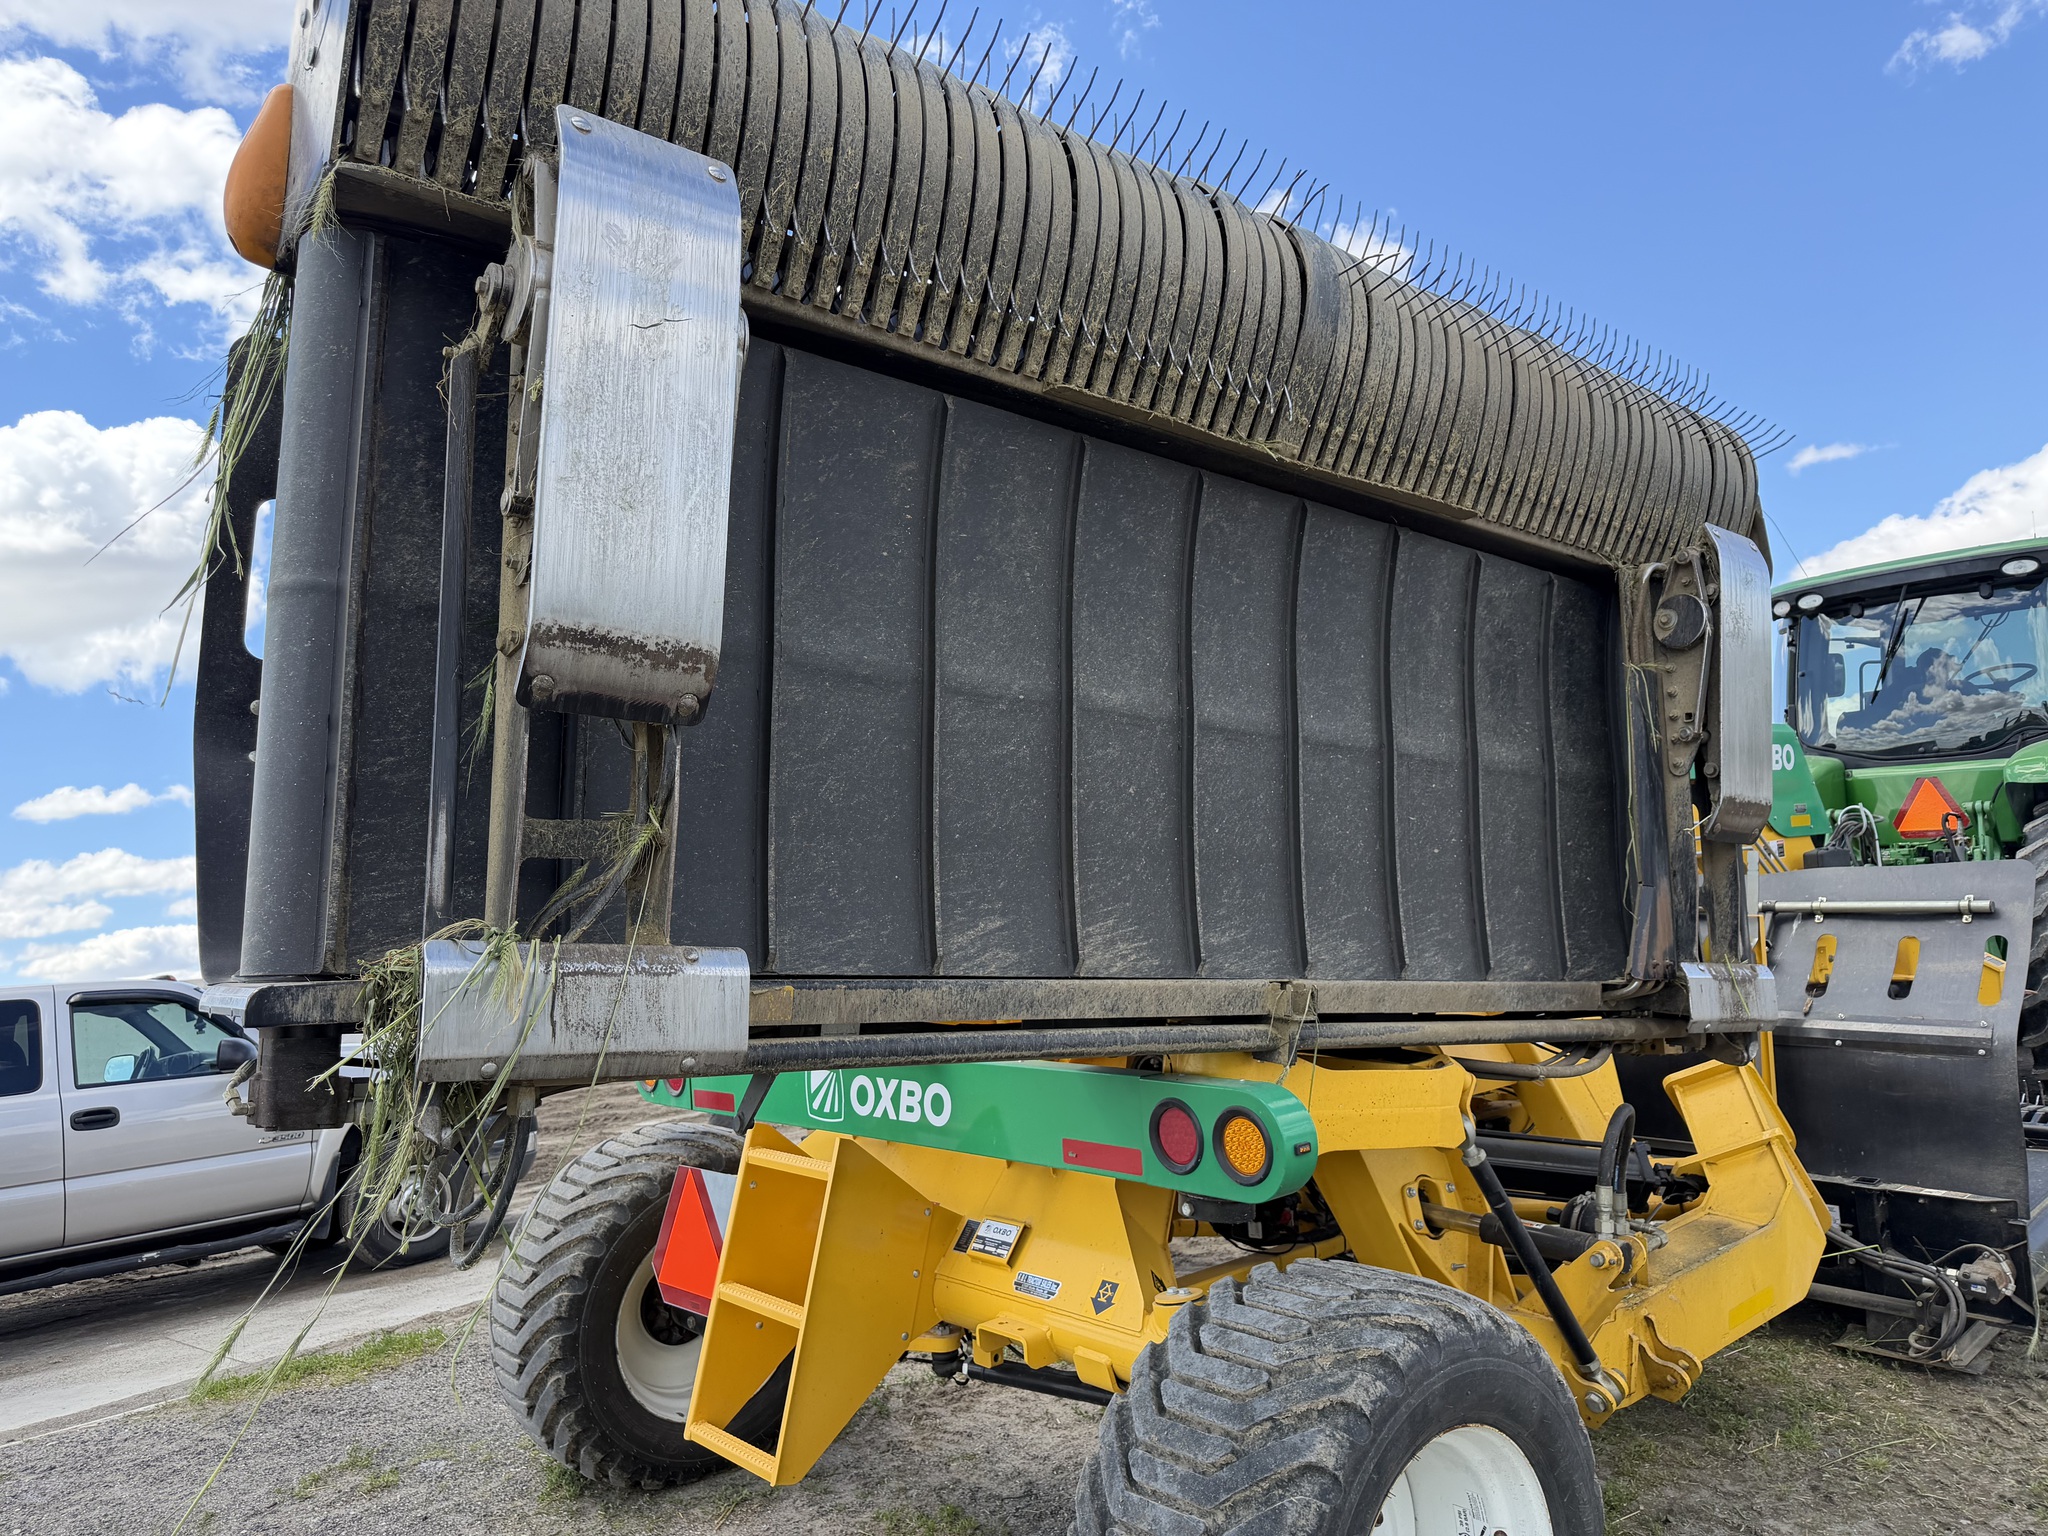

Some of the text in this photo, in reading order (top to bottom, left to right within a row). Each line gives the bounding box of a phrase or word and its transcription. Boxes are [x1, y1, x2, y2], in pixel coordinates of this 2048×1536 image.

[1771, 743, 1795, 771] BO
[850, 1074, 952, 1127] OXBO
[992, 1226, 1012, 1237] OXBO
